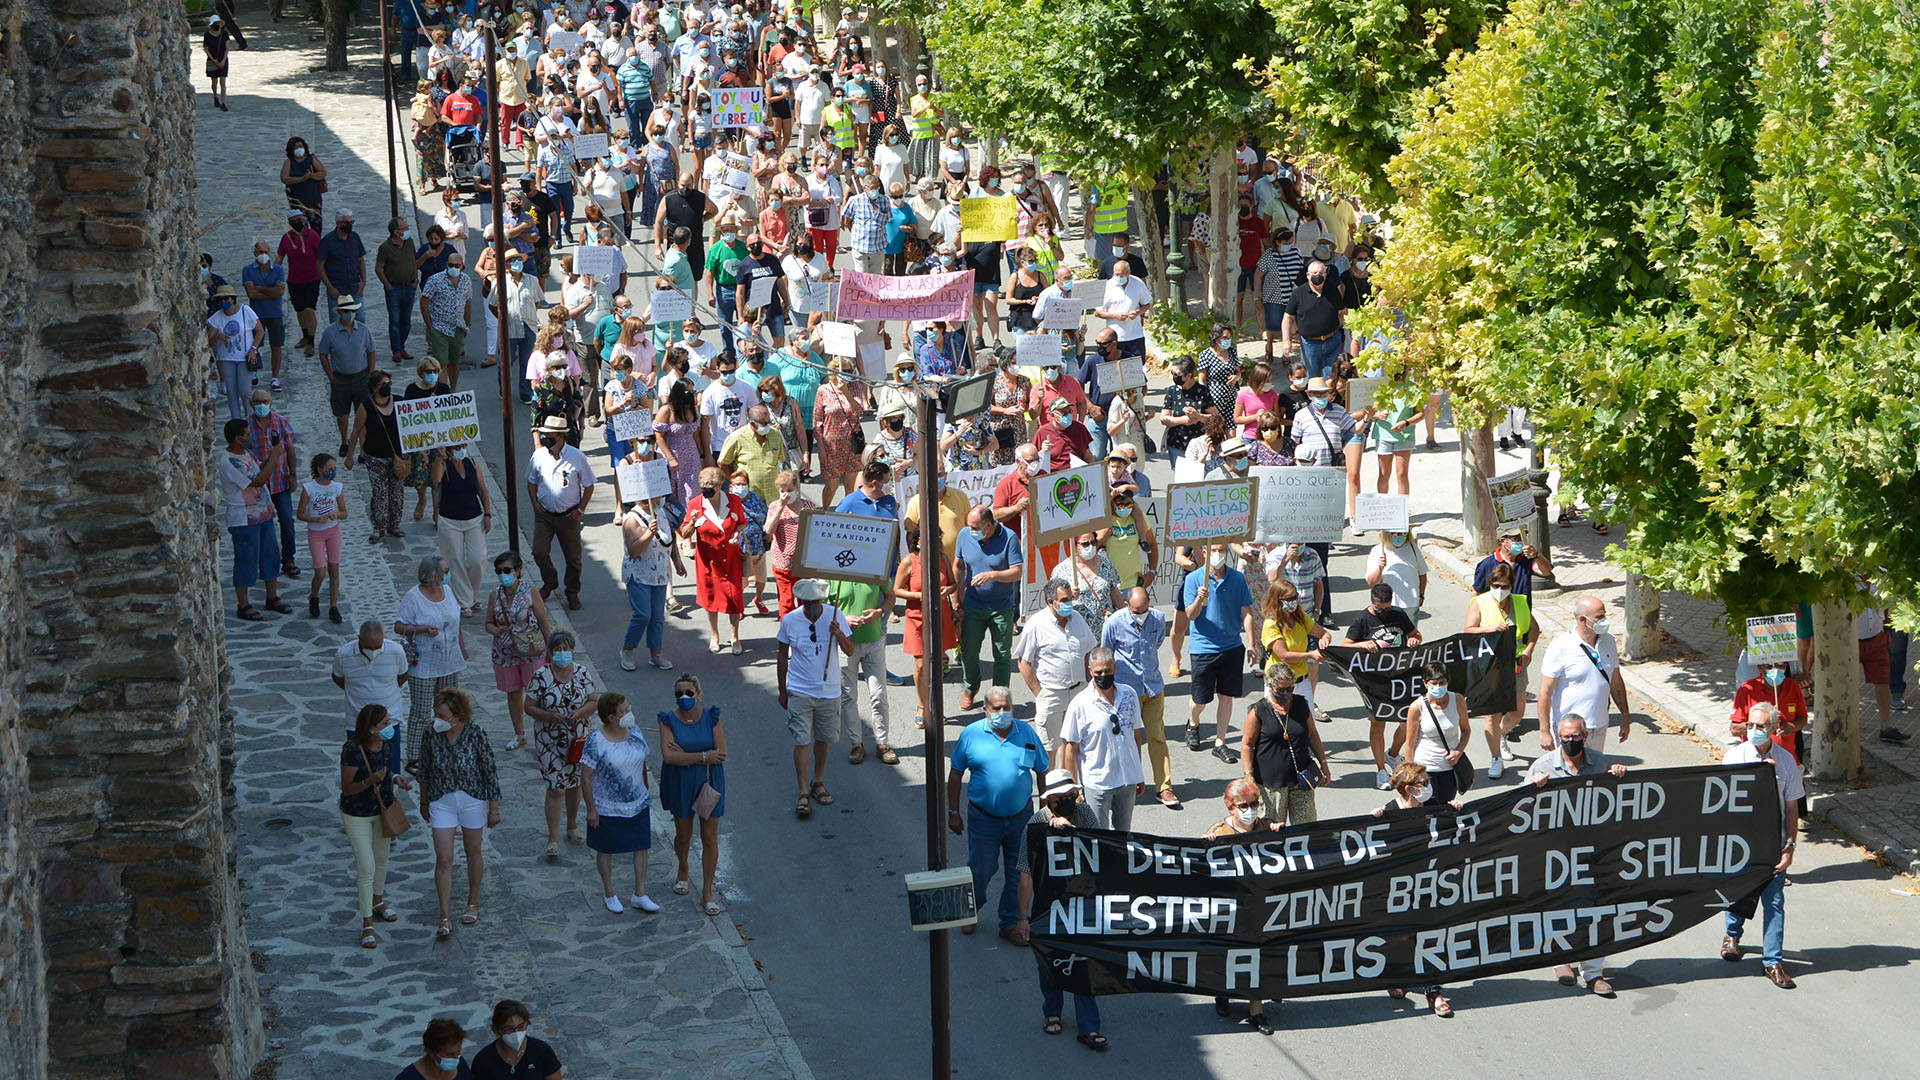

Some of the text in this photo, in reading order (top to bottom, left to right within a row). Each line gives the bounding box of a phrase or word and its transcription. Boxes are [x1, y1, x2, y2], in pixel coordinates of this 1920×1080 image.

[712, 90, 761, 105] TOY MU
[713, 111, 763, 126] CABREAU
[848, 272, 873, 289] NAVA
[878, 277, 894, 291] DE
[898, 279, 912, 291] LA
[844, 287, 867, 301] POR
[839, 303, 970, 320] NO A LOS RECORTES
[397, 393, 473, 415] POR UNA SANIDAD
[401, 411, 437, 428] DIGNA
[401, 423, 478, 451] NAVAS DE ORO
[1267, 475, 1276, 486] A
[1278, 475, 1302, 487] LOS
[1184, 486, 1249, 505] MEJOR
[1172, 501, 1249, 522] SANIDAD
[814, 520, 887, 534] STOP RECORTES
[1171, 515, 1248, 532] AL 100% CON
[835, 532, 878, 543] SANIDAD
[1172, 527, 1228, 539] POTENCIAL
[1349, 637, 1495, 673] ALDEHUELA
[1046, 774, 1756, 878] EN DEFENSA DE LA SANIDAD DE
[1050, 834, 1752, 936] NUESTRA ZONA BÁSICA DE SALUD
[1126, 898, 1675, 989] NO A LOS RECORTES
